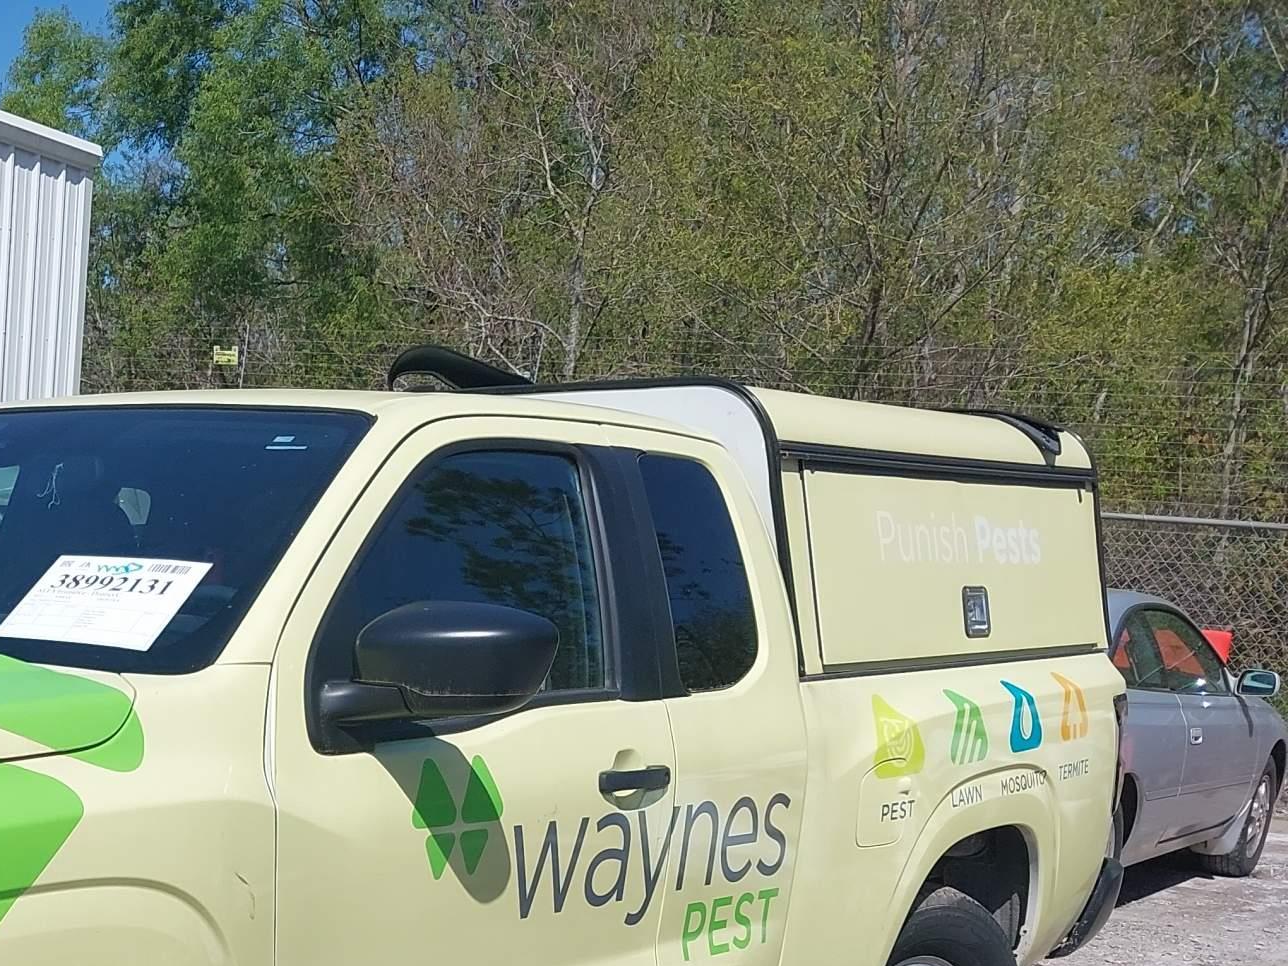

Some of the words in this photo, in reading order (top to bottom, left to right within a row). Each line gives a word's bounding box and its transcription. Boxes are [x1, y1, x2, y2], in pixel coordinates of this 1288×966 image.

[876, 510, 969, 563] Punish
[973, 514, 1041, 564] Pests
[50, 573, 174, 596] 38992131
[1058, 758, 1089, 781] TERMITE
[1000, 769, 1047, 796] MOSQUITO
[951, 784, 983, 808] LAWN
[880, 799, 916, 823] PEST
[513, 792, 792, 926] waynes
[680, 886, 781, 962] PEST
